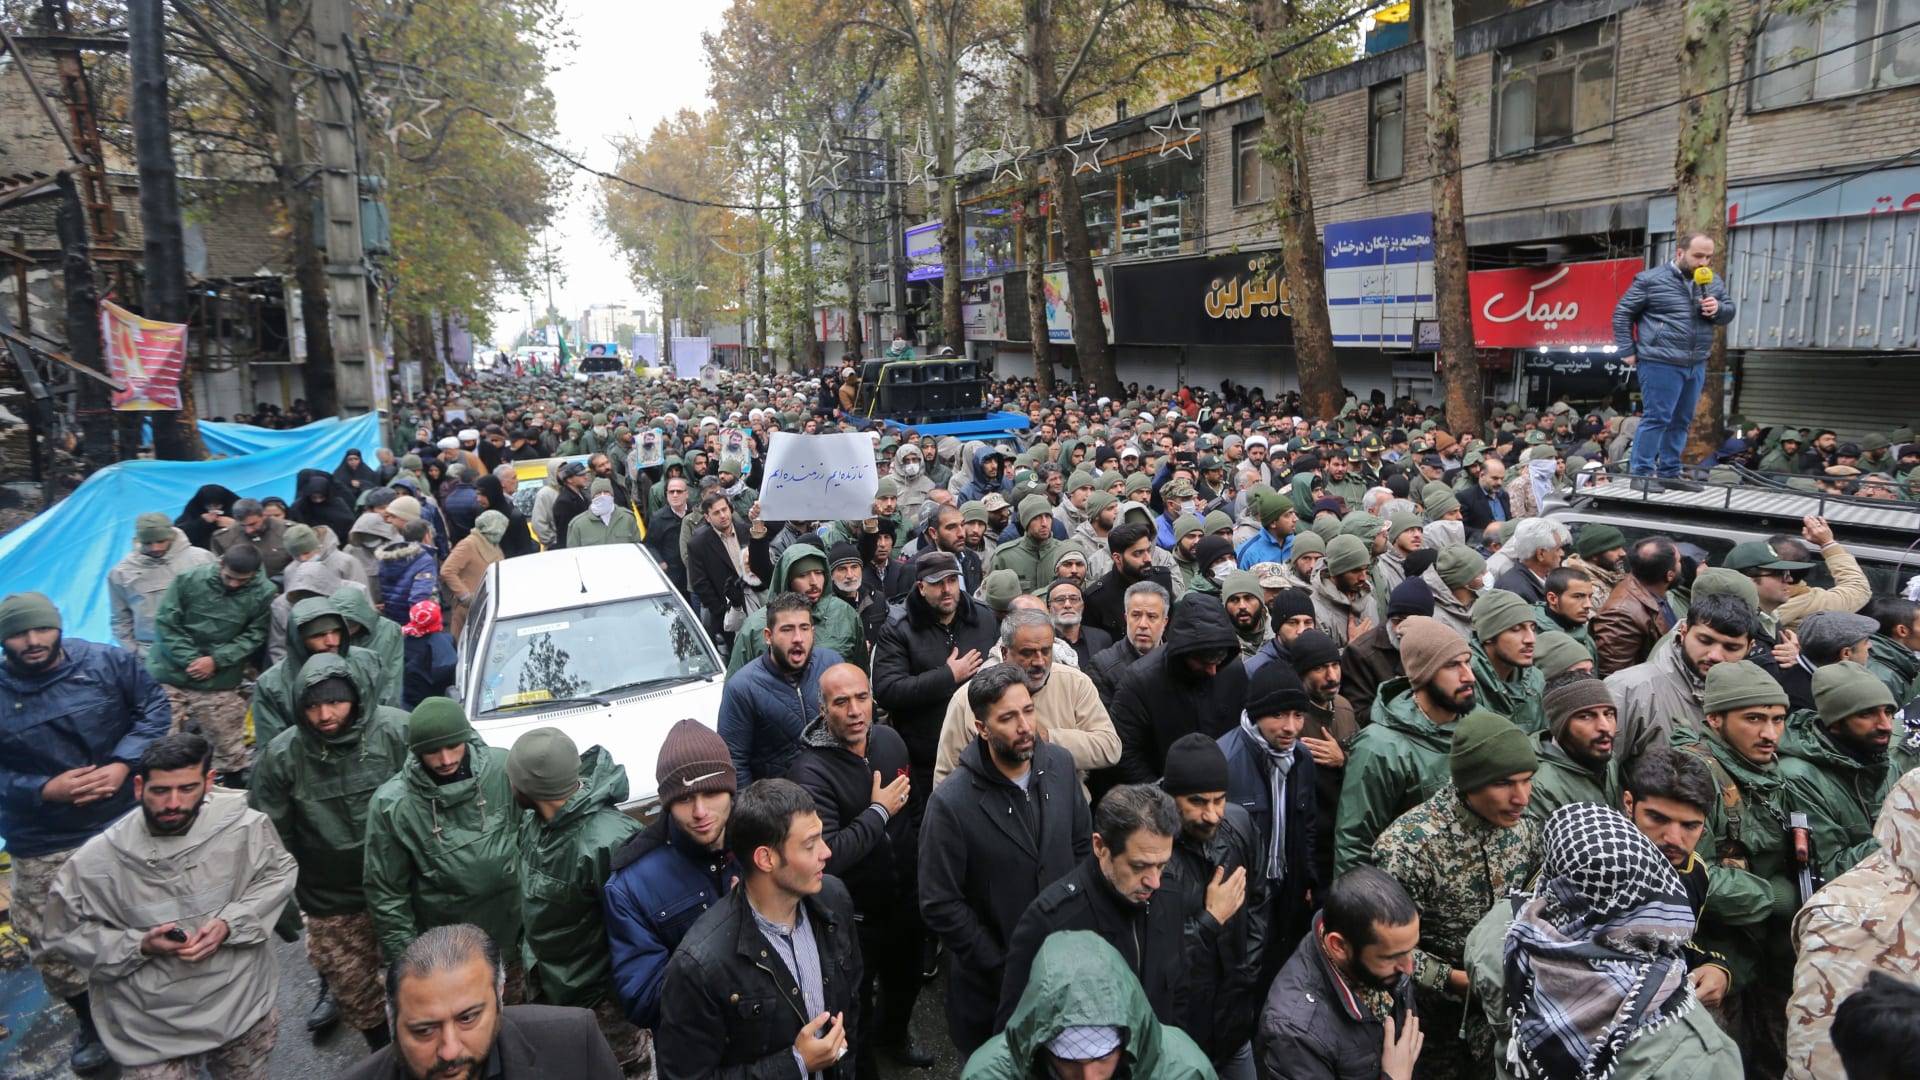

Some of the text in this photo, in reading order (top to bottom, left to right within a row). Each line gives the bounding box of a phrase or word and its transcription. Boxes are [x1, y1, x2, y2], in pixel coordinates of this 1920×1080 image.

[1330, 234, 1431, 257] مجتمع پزشکان درخشان
[1483, 266, 1579, 330] میمک
[1527, 356, 1554, 368] خشک
[1552, 357, 1592, 375] شیرینی
